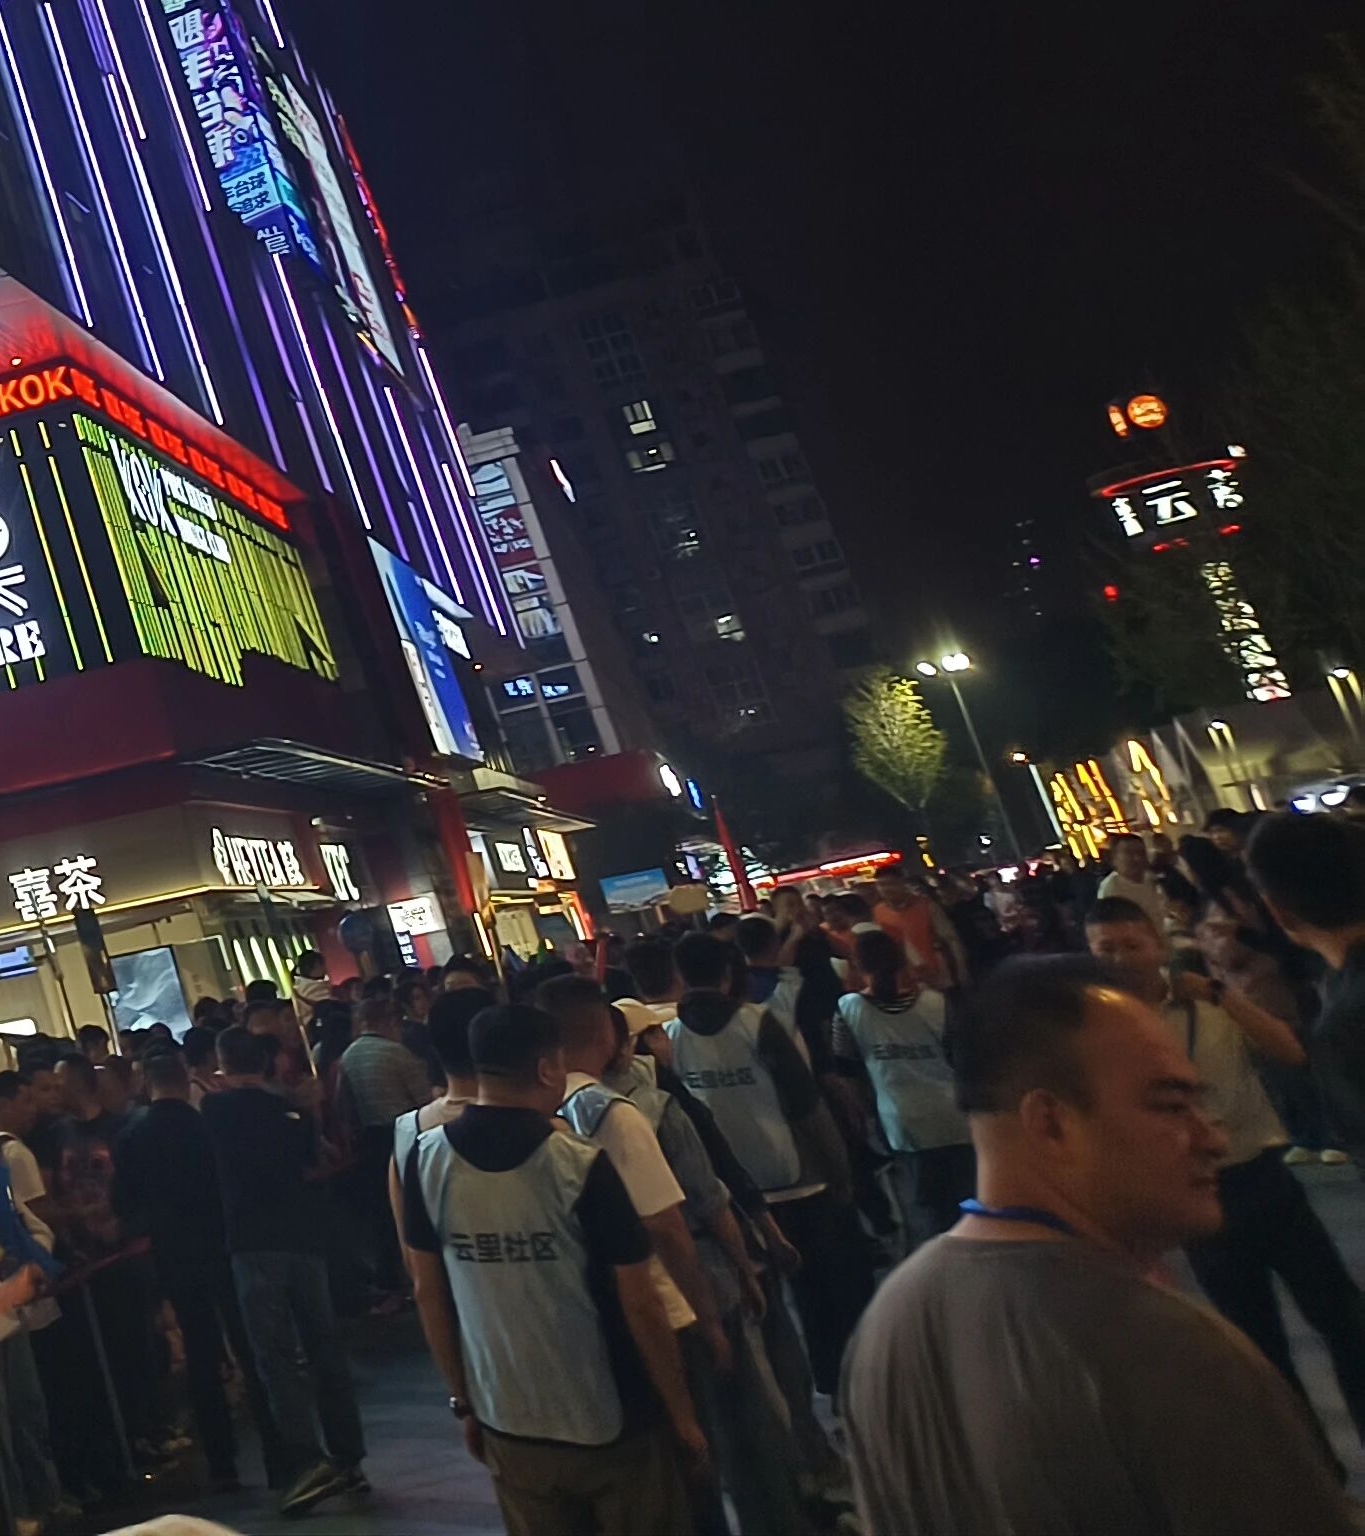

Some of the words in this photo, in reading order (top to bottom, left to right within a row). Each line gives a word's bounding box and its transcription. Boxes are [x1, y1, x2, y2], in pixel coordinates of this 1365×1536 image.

[9, 855, 107, 922] 喜茶
[449, 1230, 560, 1264] 云里社区
